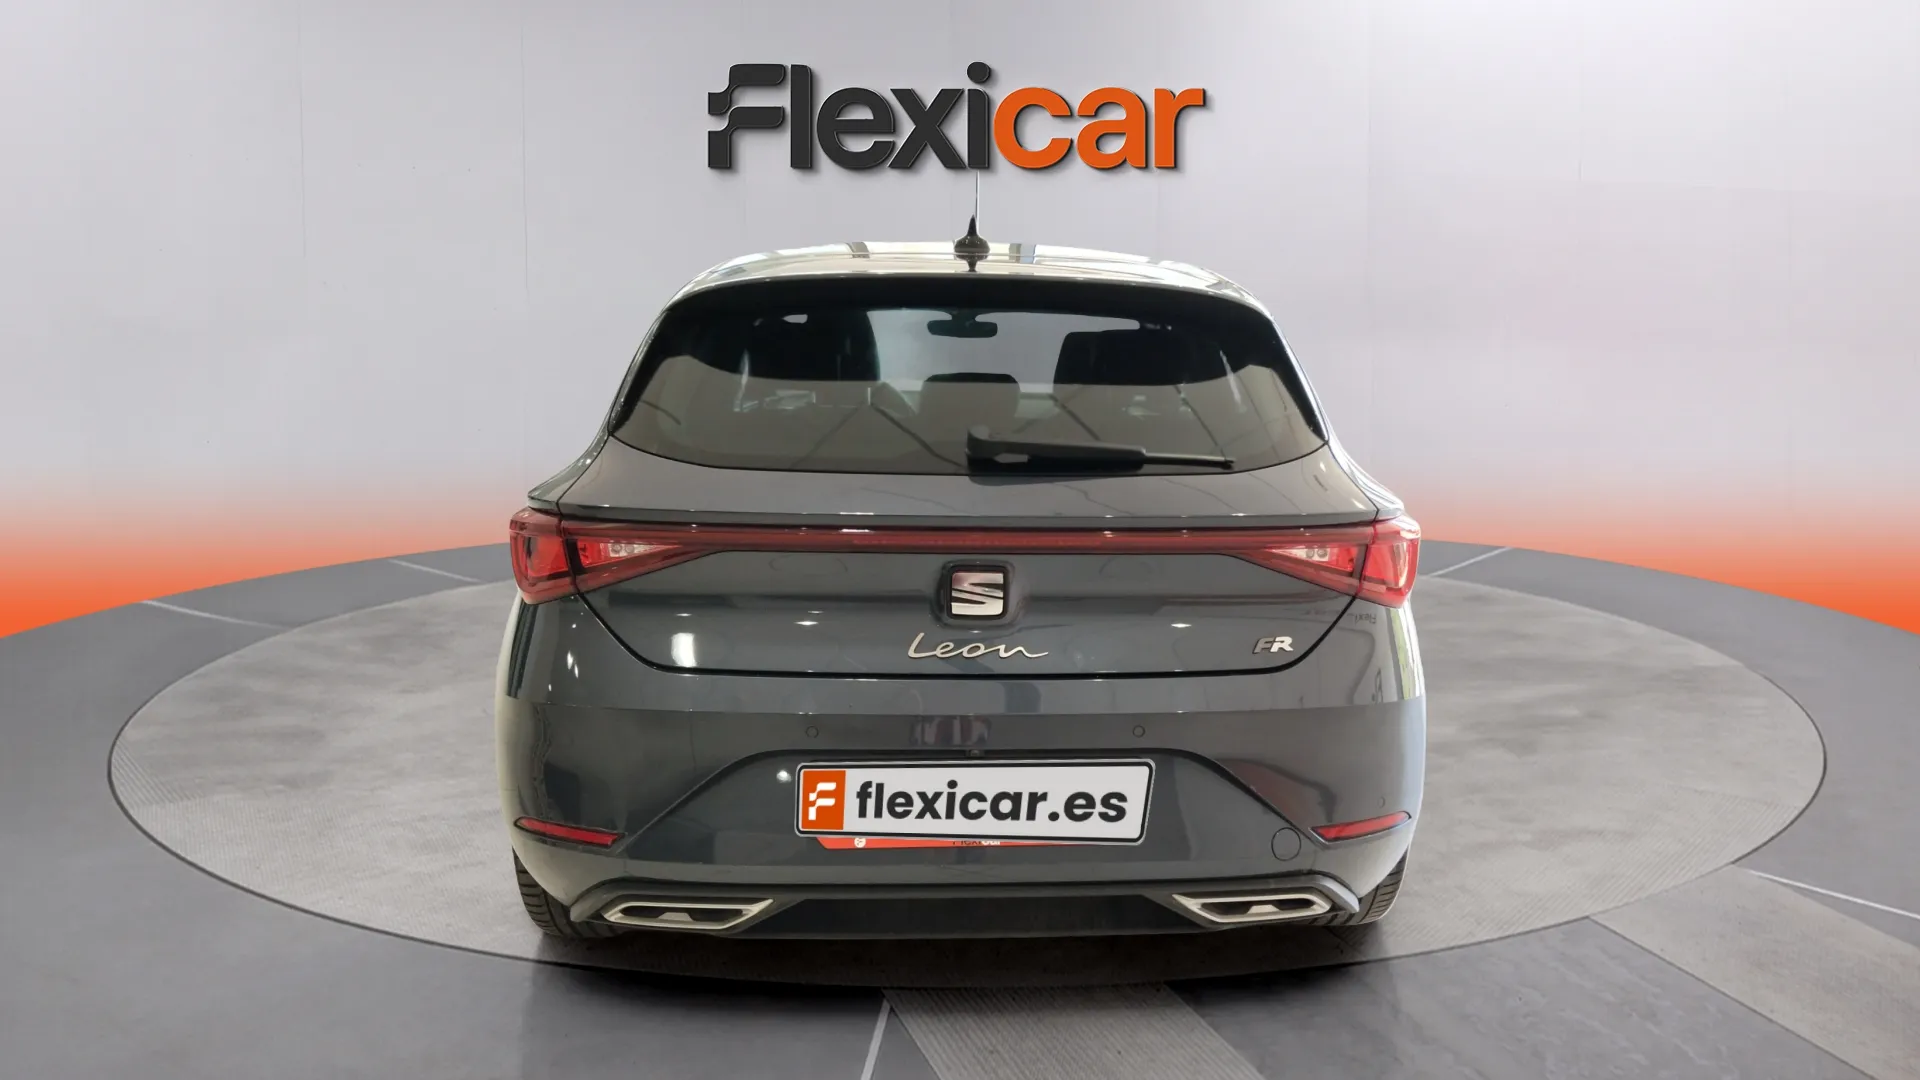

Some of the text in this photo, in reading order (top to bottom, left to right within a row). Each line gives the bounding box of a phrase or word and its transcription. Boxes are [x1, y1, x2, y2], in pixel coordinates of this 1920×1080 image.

[707, 61, 1206, 169] Flexicar
[907, 632, 1049, 658] Leon
[1252, 636, 1294, 654] FR
[856, 779, 1128, 823] flexicar.es
